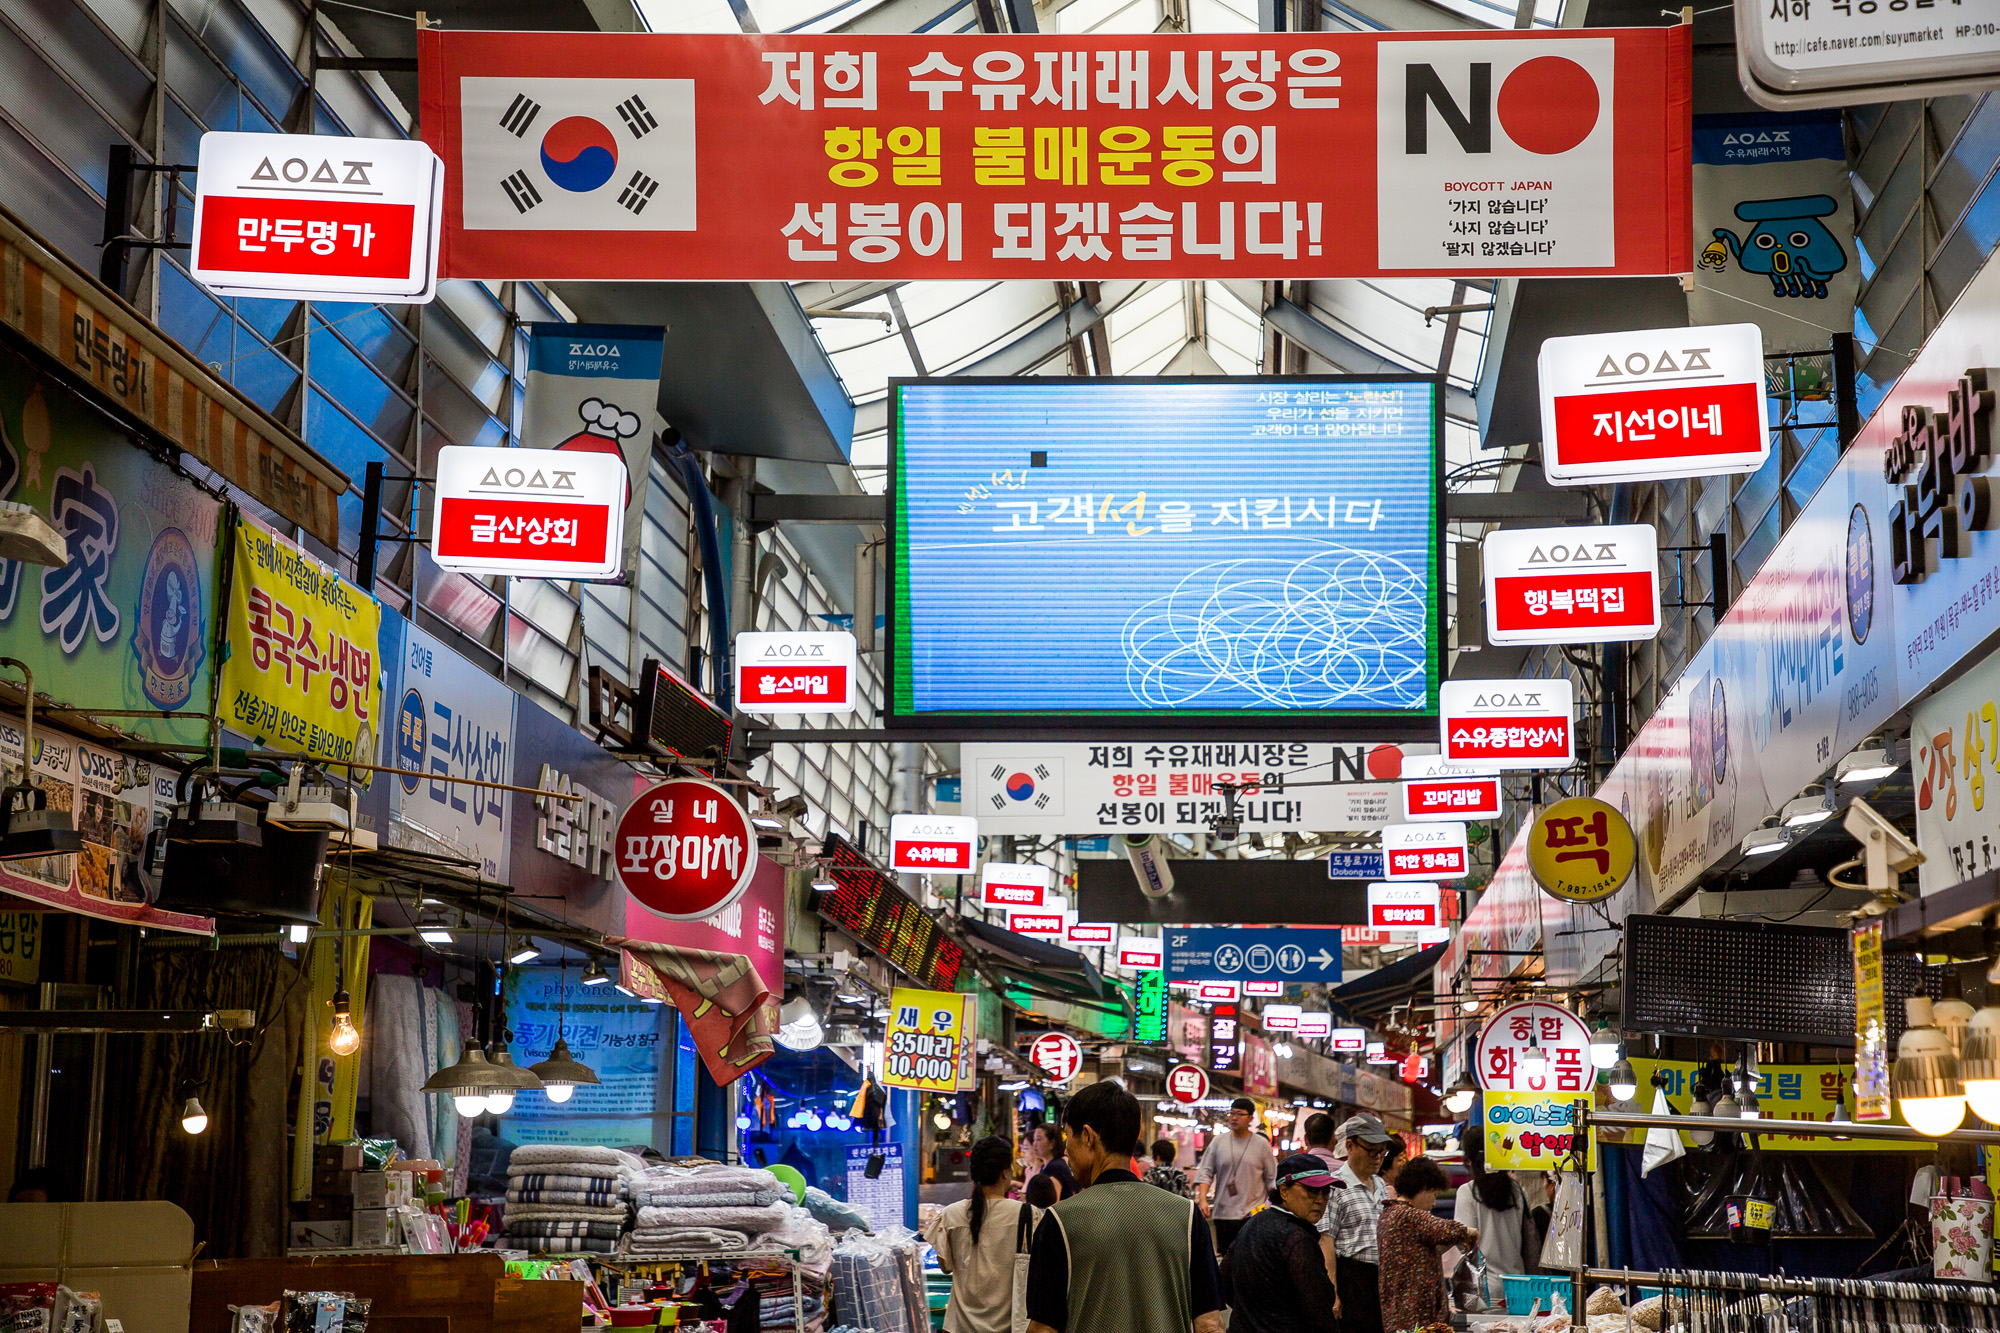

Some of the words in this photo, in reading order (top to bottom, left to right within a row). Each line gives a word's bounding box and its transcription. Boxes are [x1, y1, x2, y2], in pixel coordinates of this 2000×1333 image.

[1774, 27, 1944, 57] http://cafe.naver.com/suyumarket
[758, 50, 878, 111] 저희
[908, 48, 1341, 110] 수유재래시장은
[823, 126, 942, 188] 항일
[972, 125, 1277, 187] 불매운동의
[1444, 182, 1505, 192] BOYCOTT
[1510, 181, 1552, 191] JAPAN
[238, 217, 376, 257] 만두명가
[781, 201, 962, 262] 선봉이
[992, 200, 1323, 261] 되겠습니다!
[74, 312, 148, 412] 만두명가
[1257, 391, 1289, 404] 시장
[1266, 407, 1314, 420] 우리가
[1319, 407, 1350, 420] 선을
[1356, 407, 1403, 420] 지키면
[1592, 404, 1723, 443] 지선이네
[1251, 423, 1298, 436] 고객이
[1303, 424, 1319, 436] 더
[1885, 405, 1926, 484] cafe
[992, 490, 1197, 537] 고객선을
[1211, 496, 1385, 530] 지킵시다
[470, 514, 578, 546] 금산상회
[256, 537, 282, 579] 앞에서
[285, 555, 320, 600] 직접갈아
[1850, 532, 1869, 589] 쿠폰
[1524, 587, 1625, 616] 행복떡집
[411, 642, 433, 678] 건어물
[758, 675, 828, 695] 홈스마일
[1848, 665, 1878, 722] 988-9035
[234, 690, 279, 735] 선술거리
[280, 710, 307, 746] 안으로
[401, 711, 422, 753] 쿠폰
[1451, 726, 1565, 748] 수유종합상사
[90, 752, 113, 781] SBS
[430, 701, 506, 832] 금산상회
[1088, 745, 1132, 768] 저희
[1144, 744, 1308, 768] 수유재래시장은
[155, 777, 173, 797] KBS
[1113, 773, 1157, 797] 항일
[1422, 789, 1482, 807] 꼬마김밥
[1097, 802, 1165, 826] 선봉이
[622, 834, 742, 880] 포장마차
[1545, 811, 1610, 875] 떡
[1332, 868, 1376, 877] Dobong-ro
[1382, 908, 1425, 922] 평화상회
[1171, 936, 1188, 947] 2F
[638, 1033, 660, 1047] 침구
[1509, 1017, 1563, 1041] 종합
[891, 1031, 954, 1059] 35마리
[889, 1054, 953, 1082] 10,000
[1489, 1104, 1574, 1126] 아이스크
